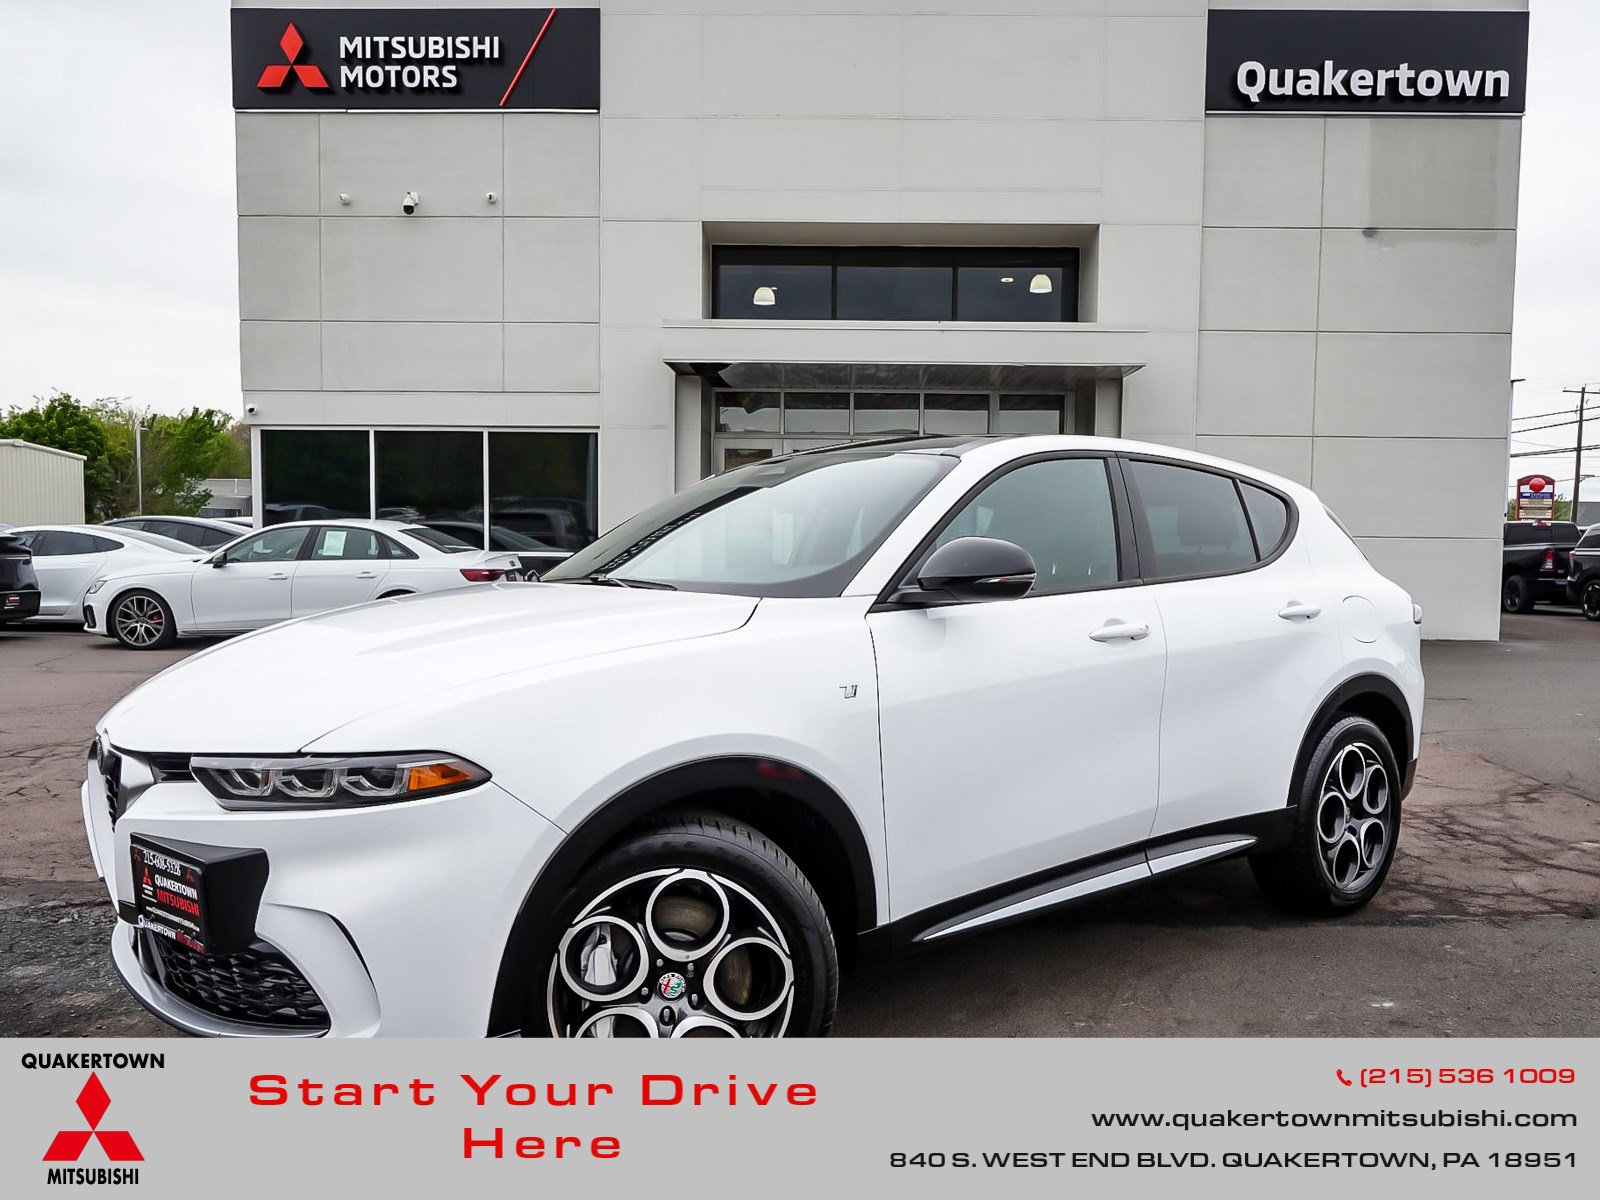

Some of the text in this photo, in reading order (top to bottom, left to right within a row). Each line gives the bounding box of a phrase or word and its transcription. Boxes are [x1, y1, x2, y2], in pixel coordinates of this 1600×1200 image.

[339, 35, 500, 59] MITSUBISHI
[340, 65, 458, 88] MOTORS
[1236, 60, 1511, 103] Quakertown
[154, 874, 198, 900] QUAKERTOWN
[156, 889, 201, 917] MITSUBISHI
